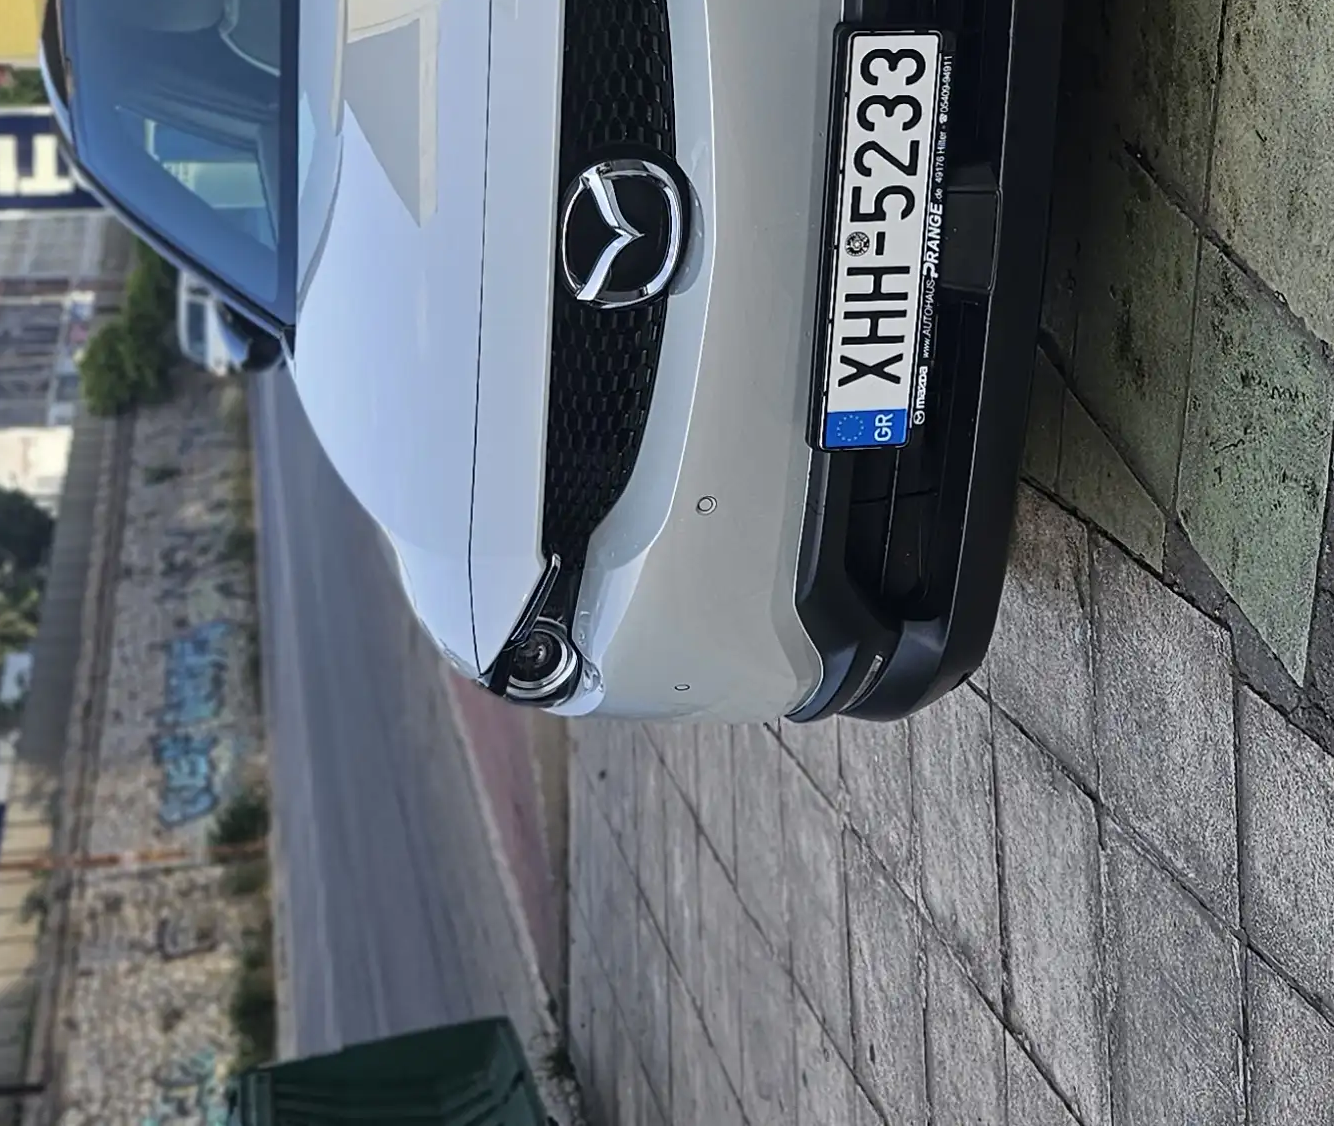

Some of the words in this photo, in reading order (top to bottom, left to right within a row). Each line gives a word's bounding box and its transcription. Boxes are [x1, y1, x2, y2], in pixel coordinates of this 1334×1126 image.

[935, 156, 945, 184] 49176
[838, 48, 927, 388] XHH-5233
[874, 413, 894, 442] GR
